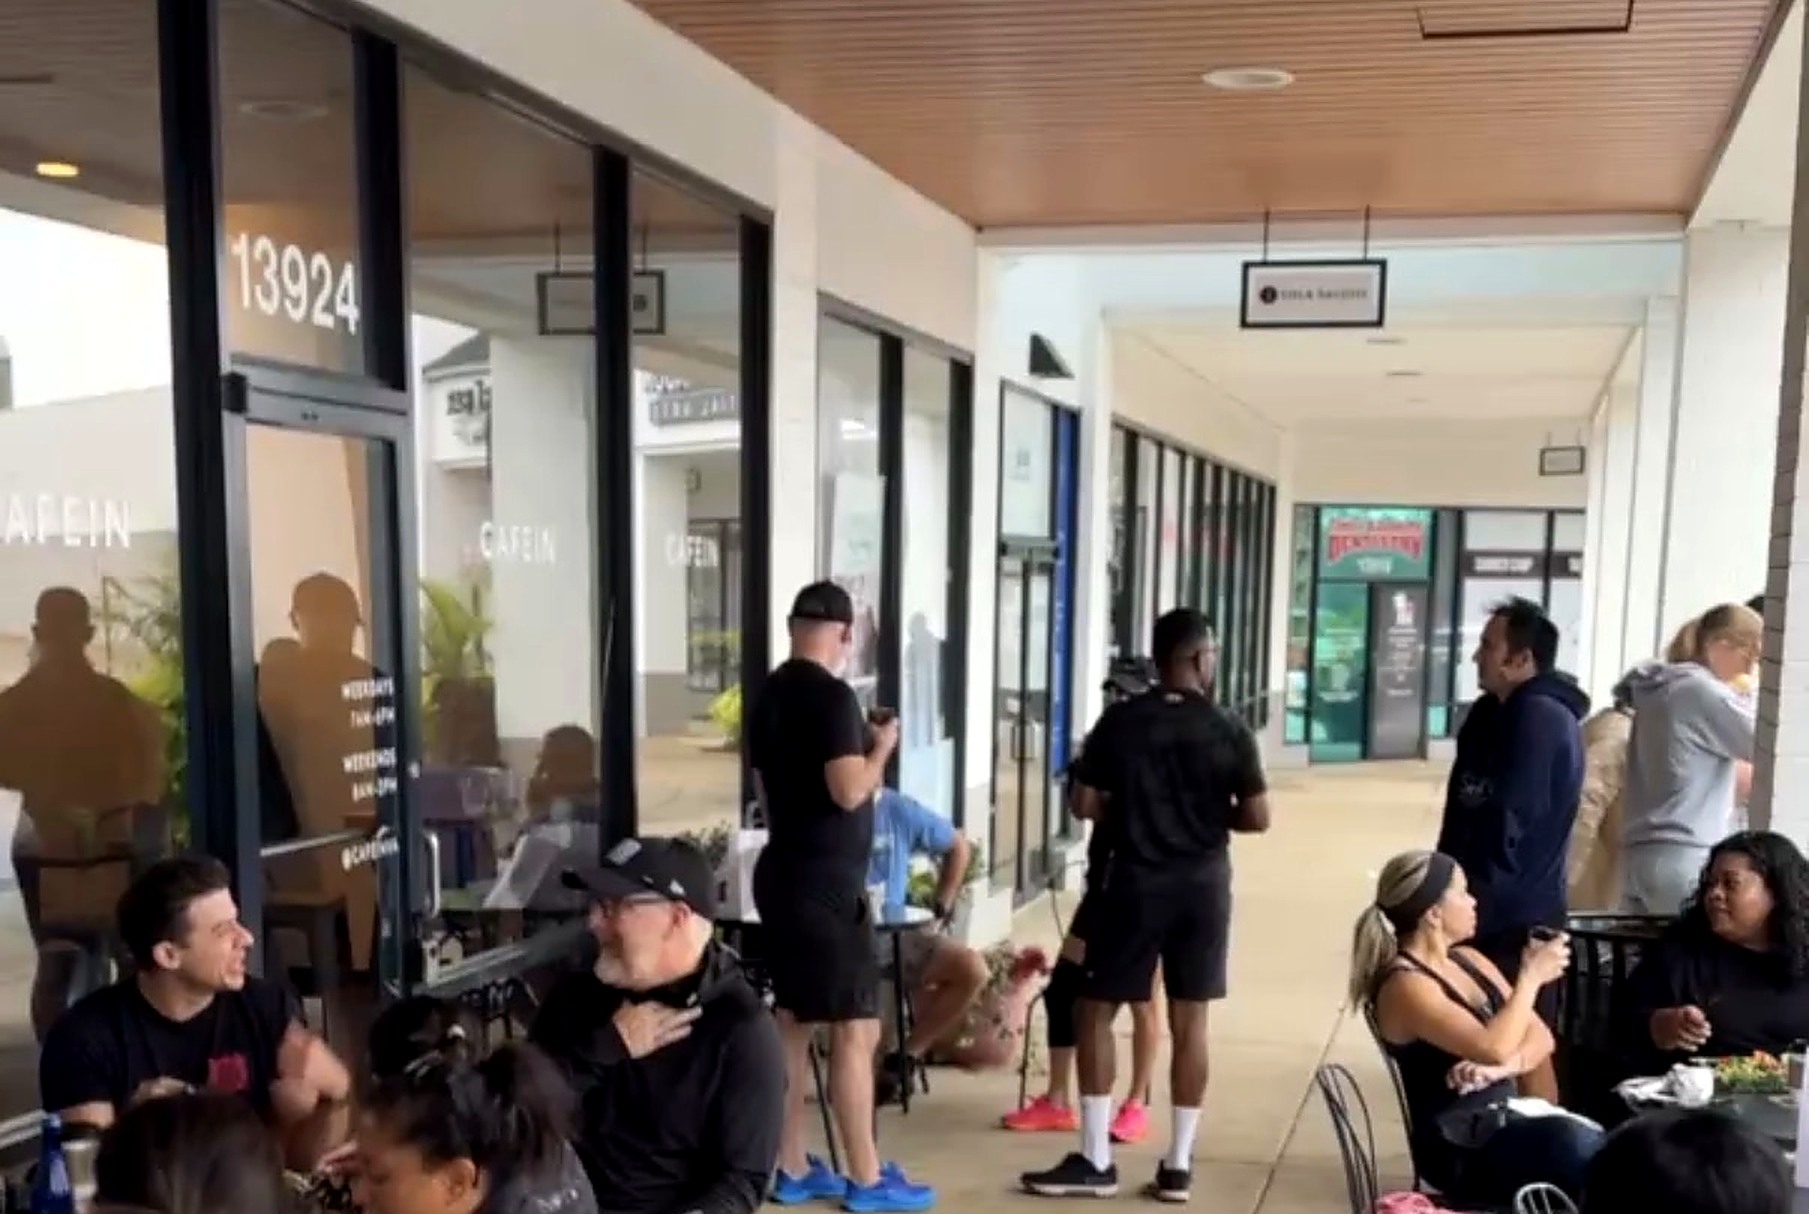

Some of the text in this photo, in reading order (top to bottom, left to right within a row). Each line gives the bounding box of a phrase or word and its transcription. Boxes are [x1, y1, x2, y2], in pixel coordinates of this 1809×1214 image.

[230, 232, 360, 336] 13924
[481, 520, 555, 565] CAFEIN
[665, 531, 719, 568] CAFEIN
[341, 676, 395, 701] WEEKDAYS
[342, 746, 397, 773] WEEKENDS
